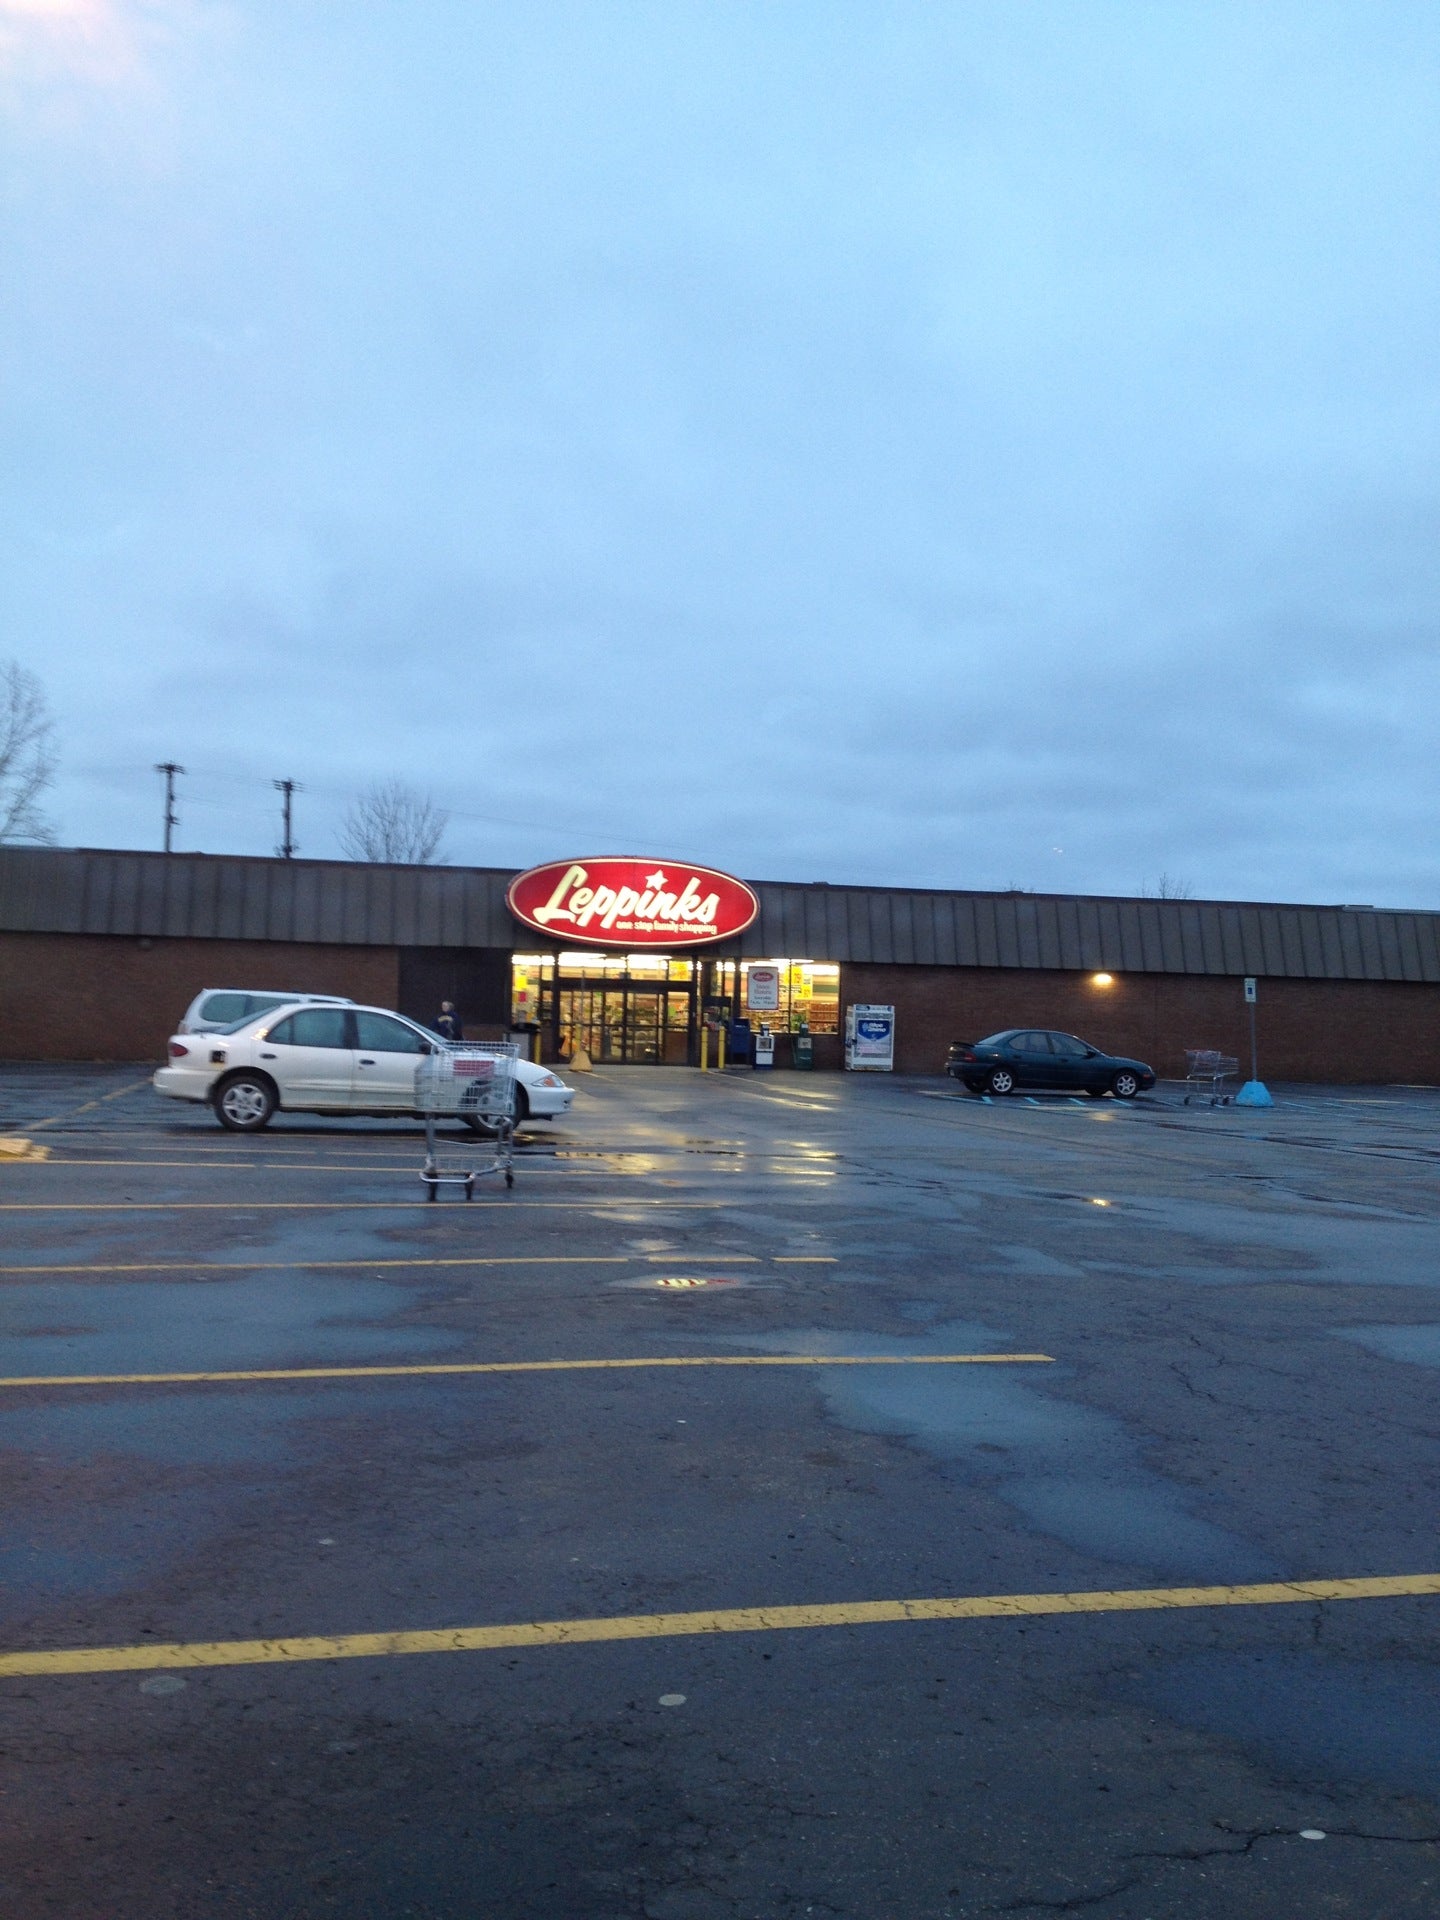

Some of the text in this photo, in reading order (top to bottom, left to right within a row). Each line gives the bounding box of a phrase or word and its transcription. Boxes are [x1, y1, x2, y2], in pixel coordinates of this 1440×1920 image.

[533, 865, 720, 929] Leppinks
[634, 920, 653, 933] stop
[653, 919, 679, 934] family
[679, 921, 718, 935] shopping
